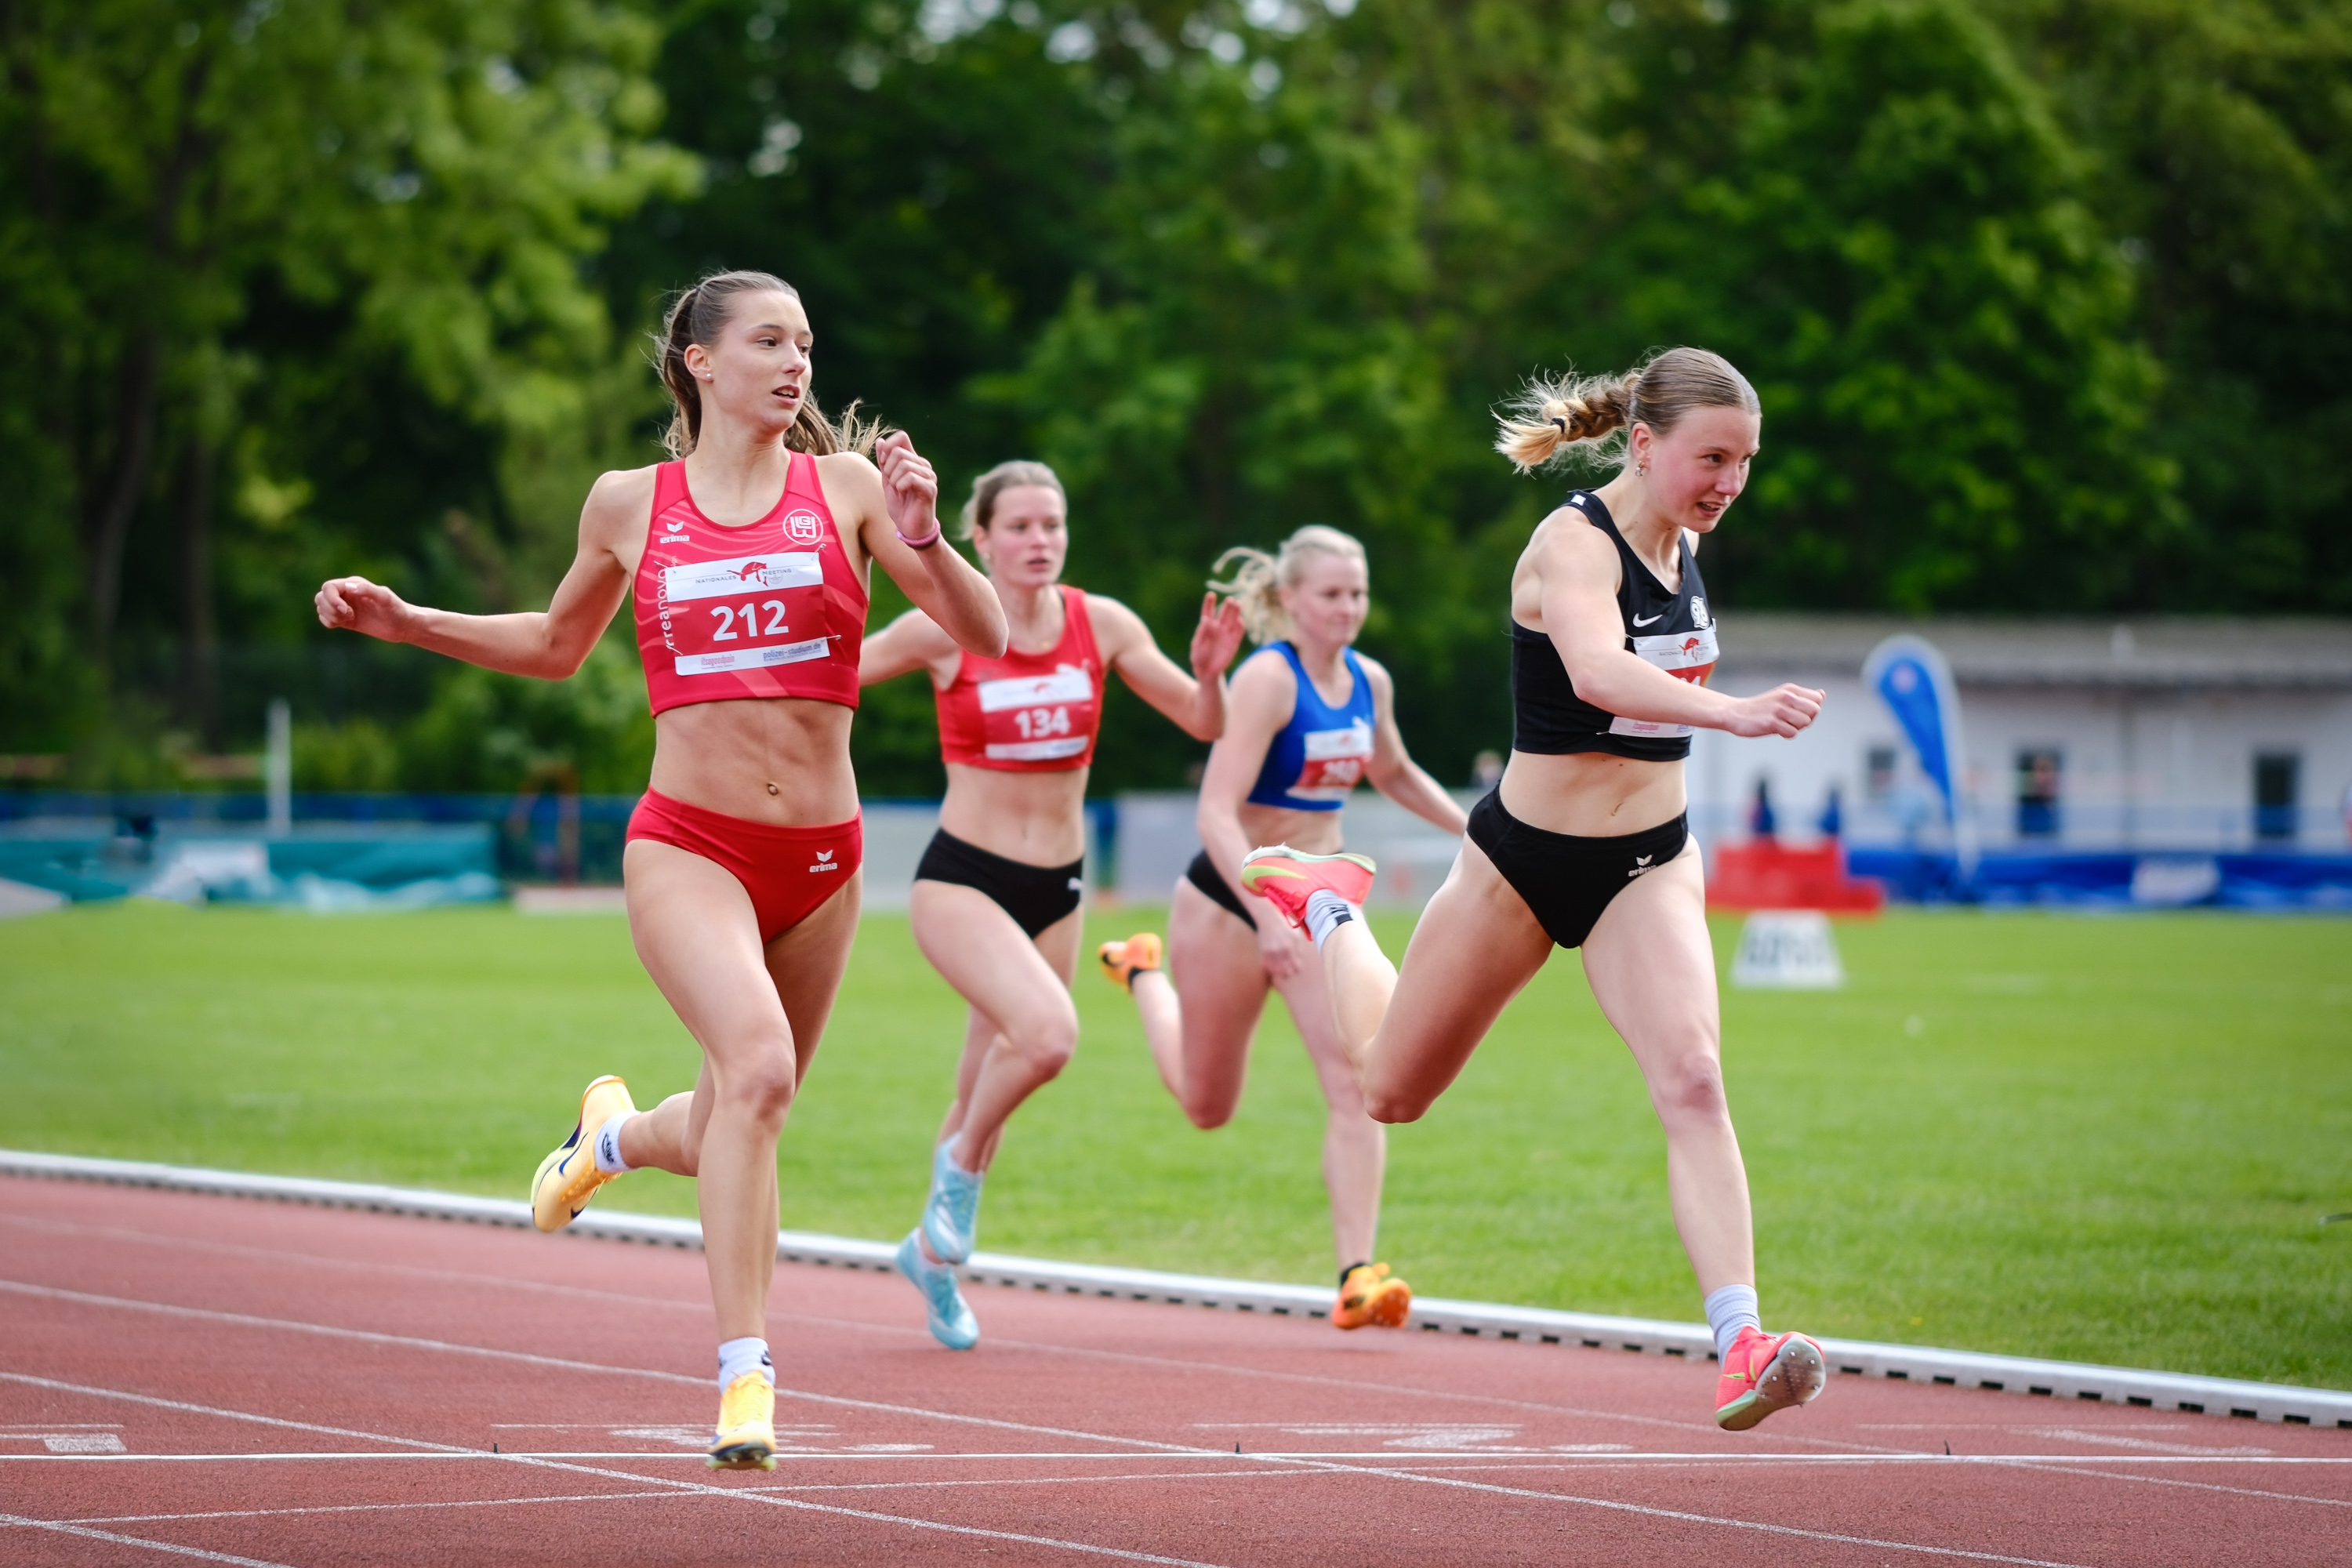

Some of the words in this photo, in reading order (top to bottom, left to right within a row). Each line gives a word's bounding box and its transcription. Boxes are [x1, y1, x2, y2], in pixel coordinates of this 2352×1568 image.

[659, 535, 691, 544] erima
[695, 575, 737, 584] NATIONALES
[710, 600, 789, 641] 212
[1014, 706, 1071, 739] 134
[809, 862, 838, 873] erima
